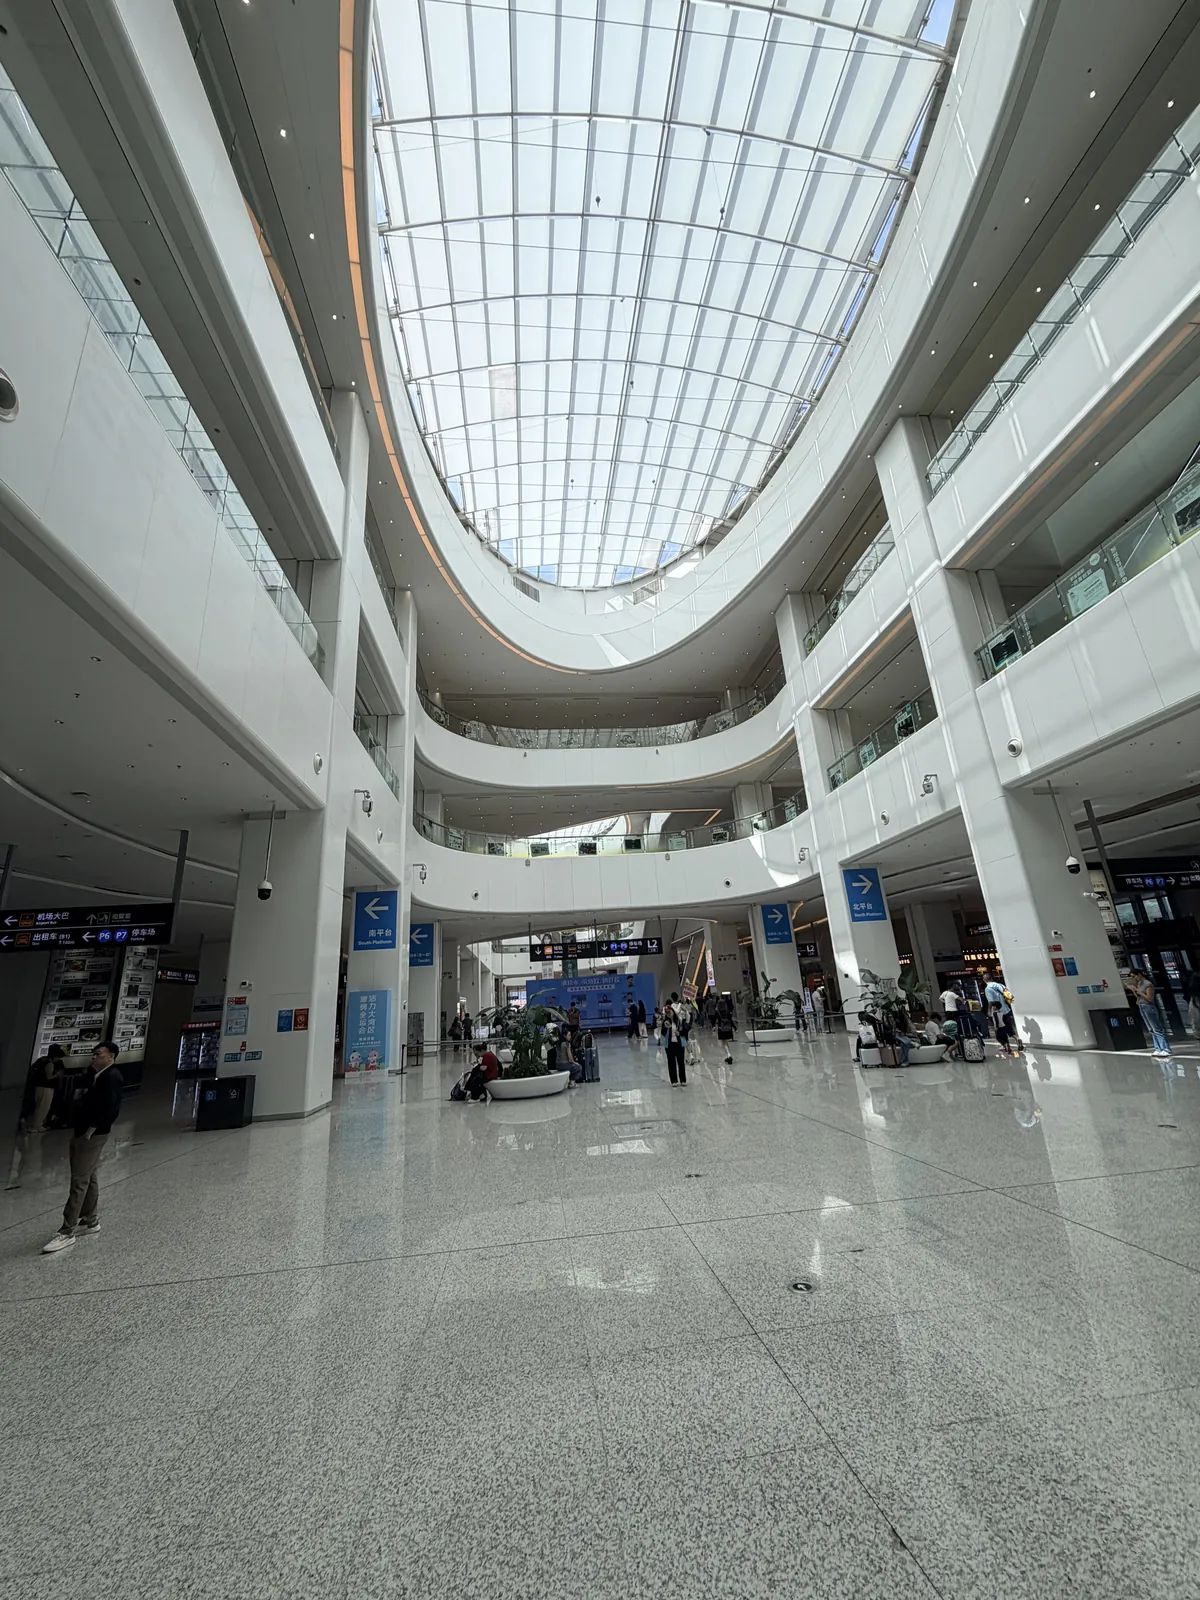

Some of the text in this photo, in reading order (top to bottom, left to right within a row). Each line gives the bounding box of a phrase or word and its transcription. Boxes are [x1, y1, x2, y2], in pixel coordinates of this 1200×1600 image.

[37, 912, 69, 920] 机场大巴
[132, 928, 155, 936] 停车场
[369, 929, 392, 937] 南平台
[33, 933, 57, 941] 出租车
[99, 933, 110, 941] P6
[647, 940, 658, 948] L2
